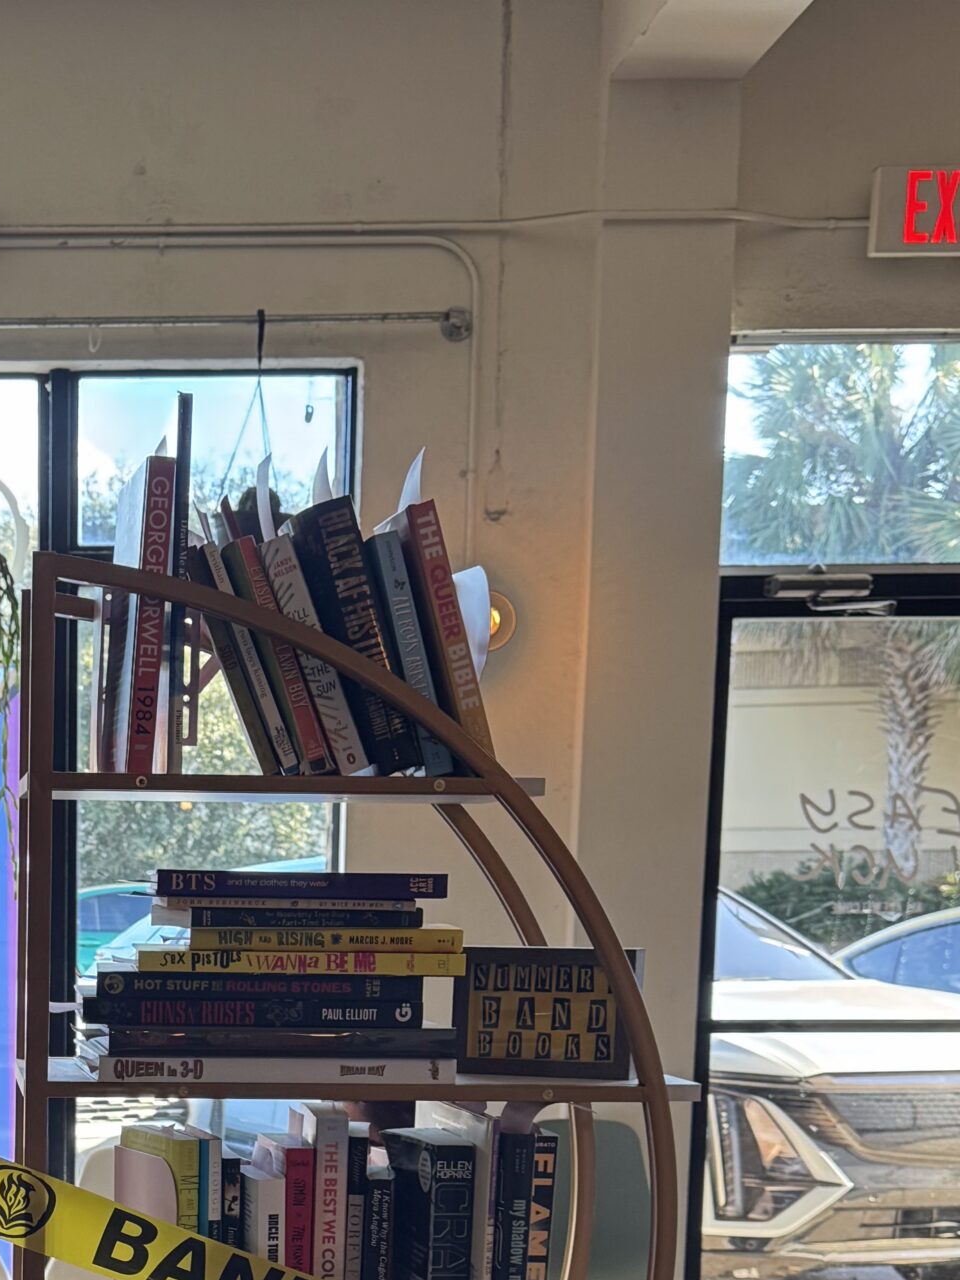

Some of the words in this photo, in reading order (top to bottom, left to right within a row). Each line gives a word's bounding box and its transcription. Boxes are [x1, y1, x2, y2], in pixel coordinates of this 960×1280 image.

[147, 475, 171, 576] GEORGE
[413, 510, 444, 560] THE
[314, 507, 366, 575] BLACK
[332, 570, 372, 604] AF
[427, 563, 464, 641] QUEER
[249, 563, 277, 612] EVISON
[274, 644, 297, 681] LAWN
[287, 681, 309, 710] BOY
[315, 681, 336, 697] SUN
[446, 642, 480, 711] BIBLE
[133, 685, 155, 736] 1984
[170, 873, 217, 891] BTS
[226, 879, 243, 887] and
[244, 879, 258, 887] the
[259, 879, 289, 887] clothes
[290, 880, 308, 889] they
[217, 931, 254, 946] HIGH
[276, 931, 326, 948] RISING
[349, 936, 380, 945] MARCUS
[390, 936, 414, 945] MOORE
[133, 979, 163, 991] HOT
[166, 979, 210, 992] STUFF
[226, 981, 288, 993] ROLLING
[291, 982, 353, 993] STONES
[476, 964, 593, 991] SUMMER
[140, 1000, 186, 1025] GUNS
[201, 1000, 256, 1025] ROSES
[321, 1008, 344, 1021] PAUL
[345, 1008, 378, 1021] ELLIOTT
[484, 999, 606, 1029] BAND
[479, 1033, 608, 1058] BOOKS
[114, 1060, 164, 1080] QUEEN
[180, 1061, 204, 1080] 3-D
[323, 1142, 339, 1174] THE
[436, 1160, 473, 1171] ELLEN
[210, 1160, 218, 1214] GEORGE
[435, 1170, 473, 1180] HOPKINS
[291, 1178, 305, 1206] SIMON
[322, 1177, 338, 1216] BEST
[371, 1188, 381, 1211] Maya
[380, 1195, 390, 1219] Know
[510, 1198, 528, 1216] my
[293, 1224, 305, 1242] THE
[321, 1218, 336, 1244] WE
[369, 1212, 379, 1246] Angelou
[378, 1221, 388, 1239] Why
[508, 1218, 527, 1264] shadow
[378, 1241, 387, 1254] the
[321, 1247, 336, 1280] COU
[376, 1255, 387, 1280] Caged
